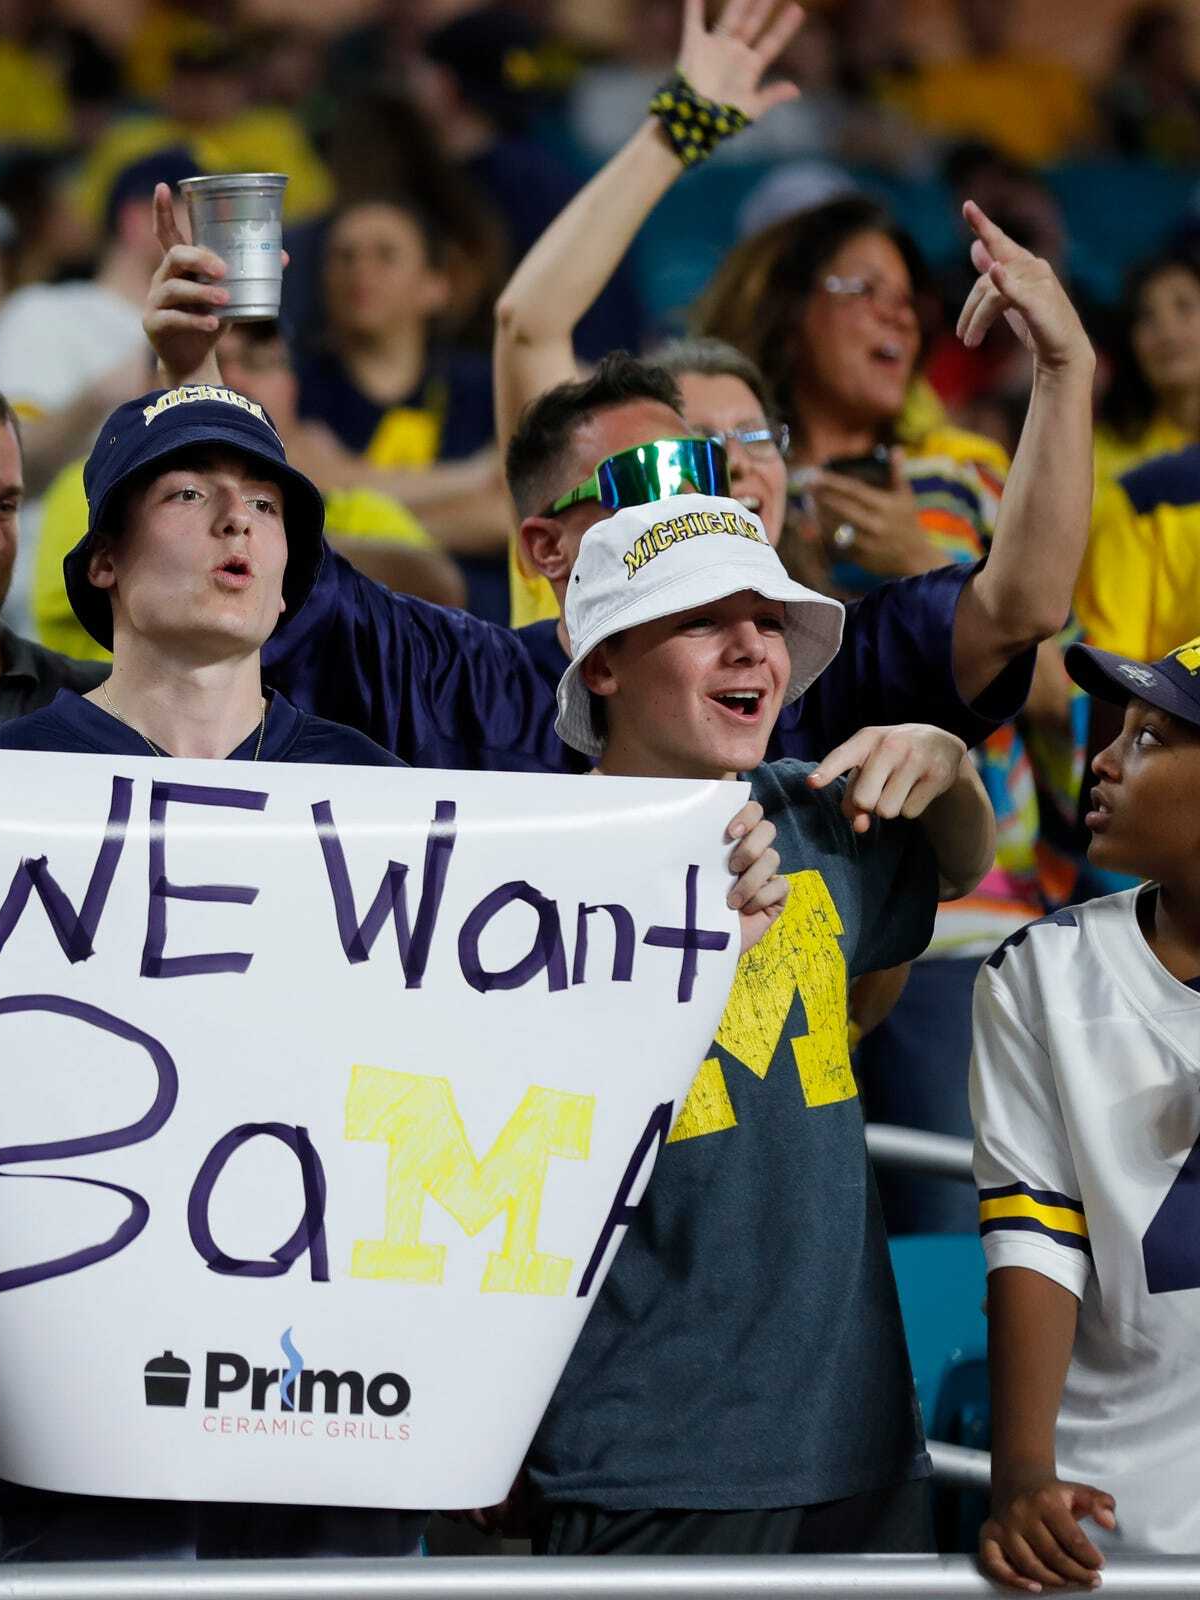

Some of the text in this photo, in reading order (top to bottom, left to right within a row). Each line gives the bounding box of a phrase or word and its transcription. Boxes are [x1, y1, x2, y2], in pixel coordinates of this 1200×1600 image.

[623, 511, 768, 580] MICHIGAN
[311, 799, 731, 1004] Want
[204, 1350, 411, 1417] Primo
[202, 1415, 411, 1441] CERAMIC GRILLS
